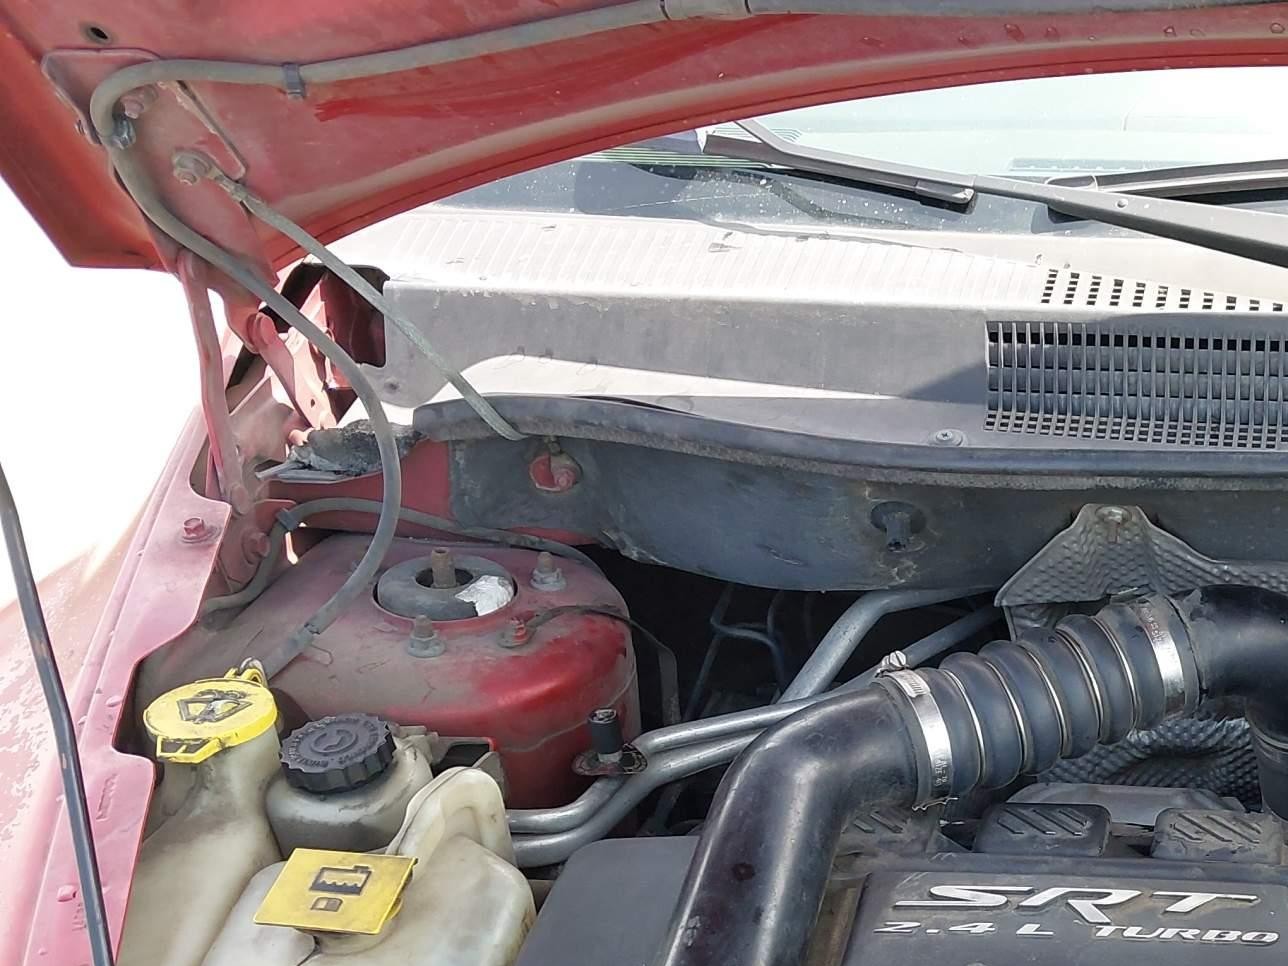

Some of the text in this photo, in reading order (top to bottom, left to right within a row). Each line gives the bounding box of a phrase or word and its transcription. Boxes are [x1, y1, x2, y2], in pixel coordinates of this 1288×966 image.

[894, 884, 1258, 923] SRT
[874, 921, 1280, 945] 2.4 L TURBO
